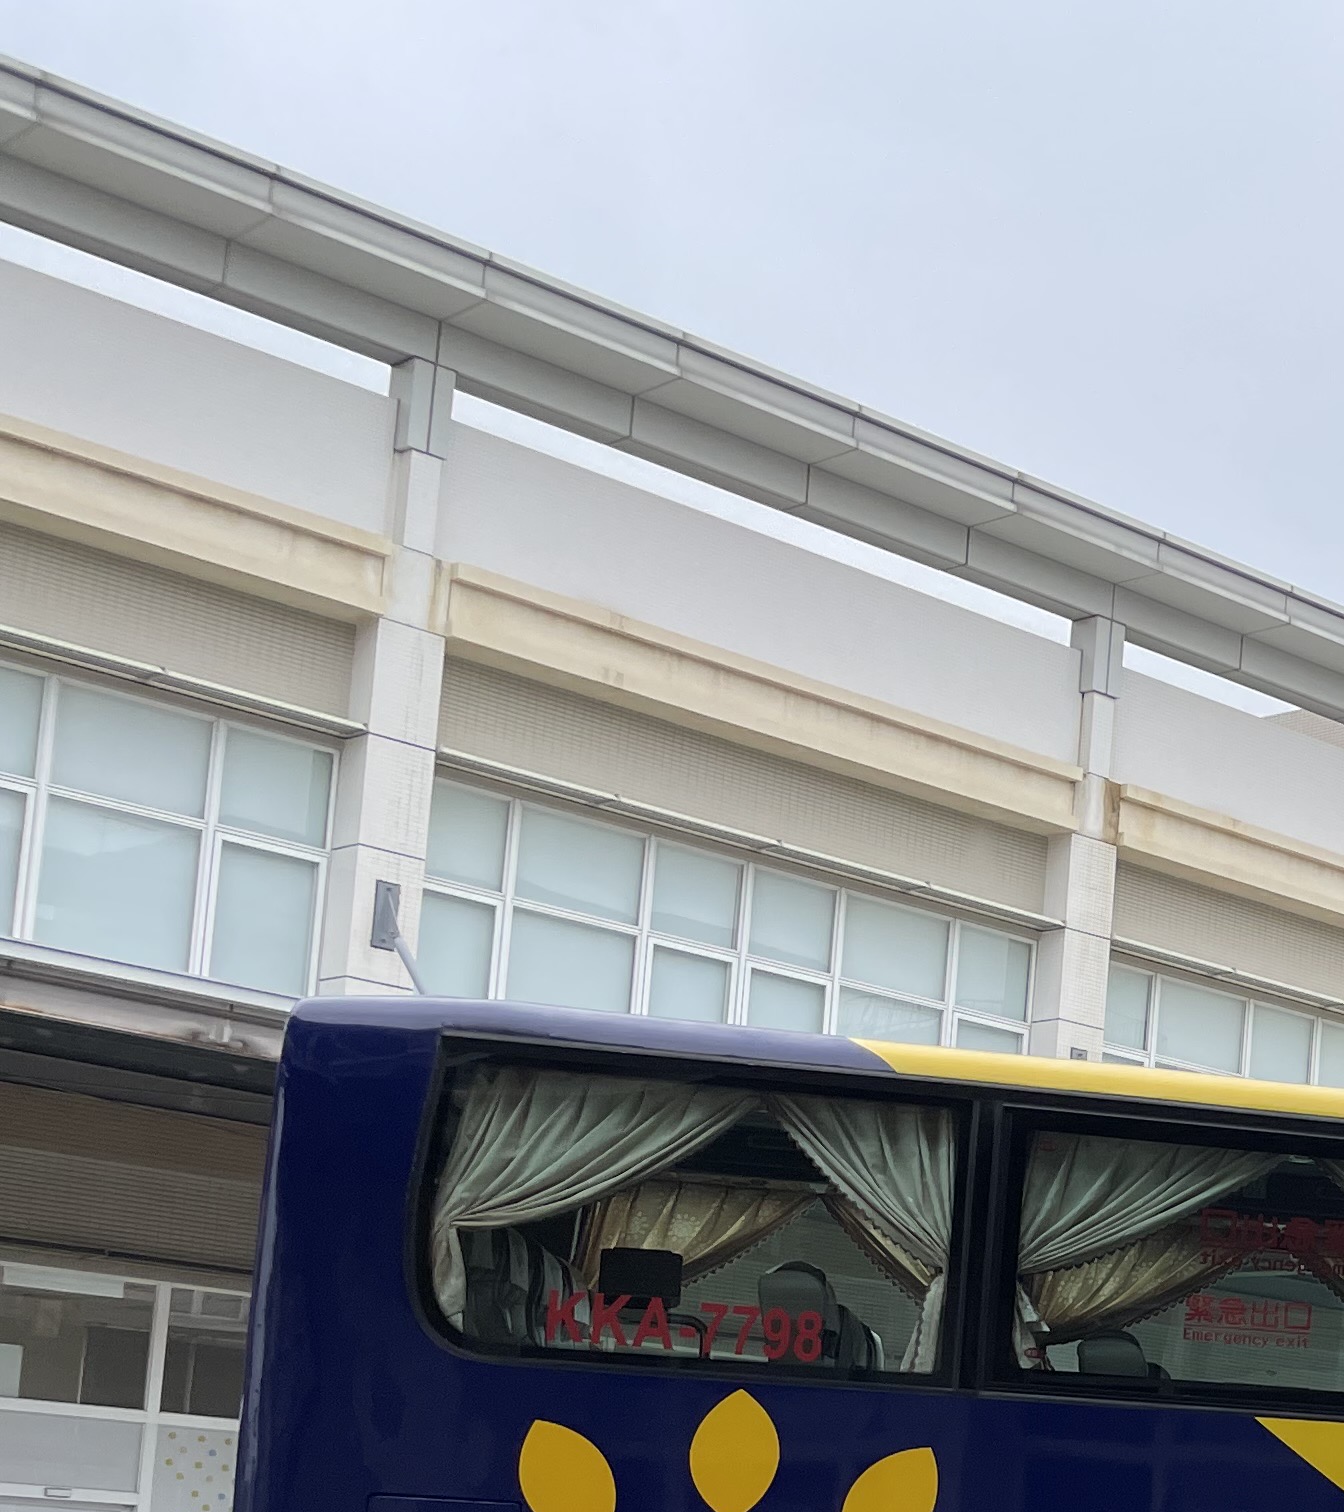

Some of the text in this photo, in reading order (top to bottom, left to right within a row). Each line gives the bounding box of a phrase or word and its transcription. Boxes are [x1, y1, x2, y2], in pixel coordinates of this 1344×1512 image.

[545, 1289, 823, 1362] KKA-7798
[1184, 1294, 1313, 1330] 緊急出口
[1183, 1327, 1309, 1348] Emergency exit
